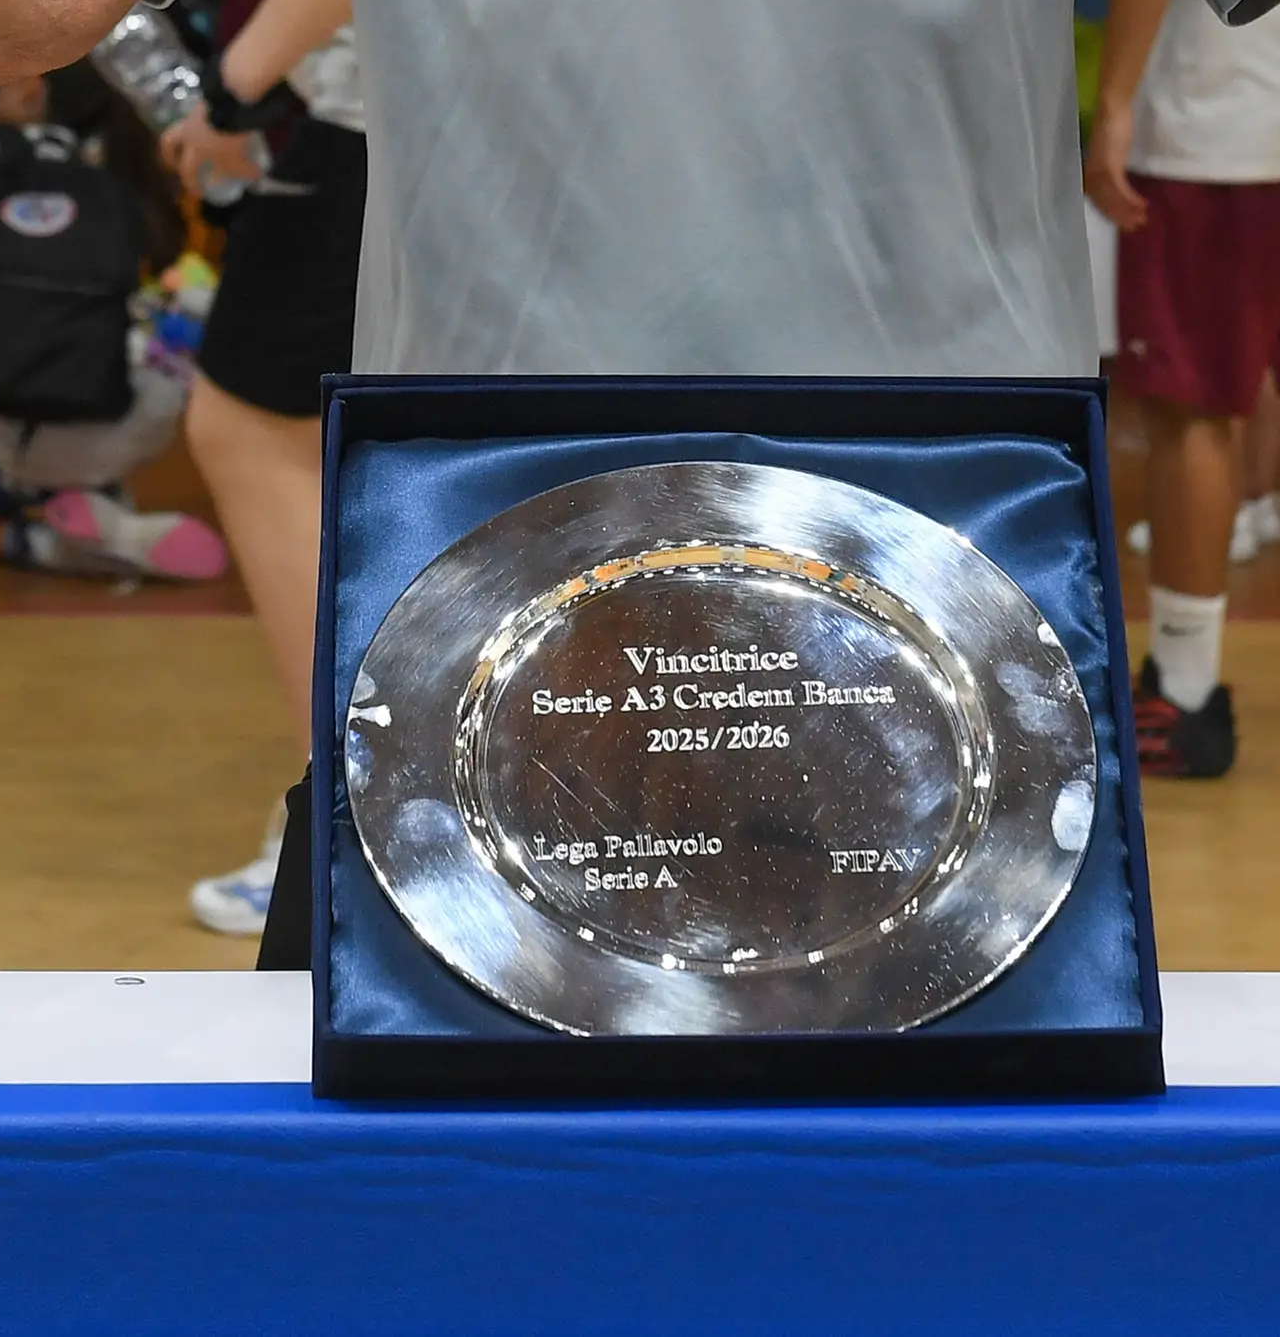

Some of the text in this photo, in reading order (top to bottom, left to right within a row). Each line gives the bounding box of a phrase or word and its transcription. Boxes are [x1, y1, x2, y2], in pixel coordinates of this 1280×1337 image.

[623, 645, 799, 675] Vincitrice
[532, 680, 896, 716] Serie A3 Credem Banca
[646, 724, 791, 753] 2025/2026
[533, 831, 724, 865] Lega Pallavolo
[829, 847, 923, 874] FIPAV
[584, 867, 678, 891] Serie A
